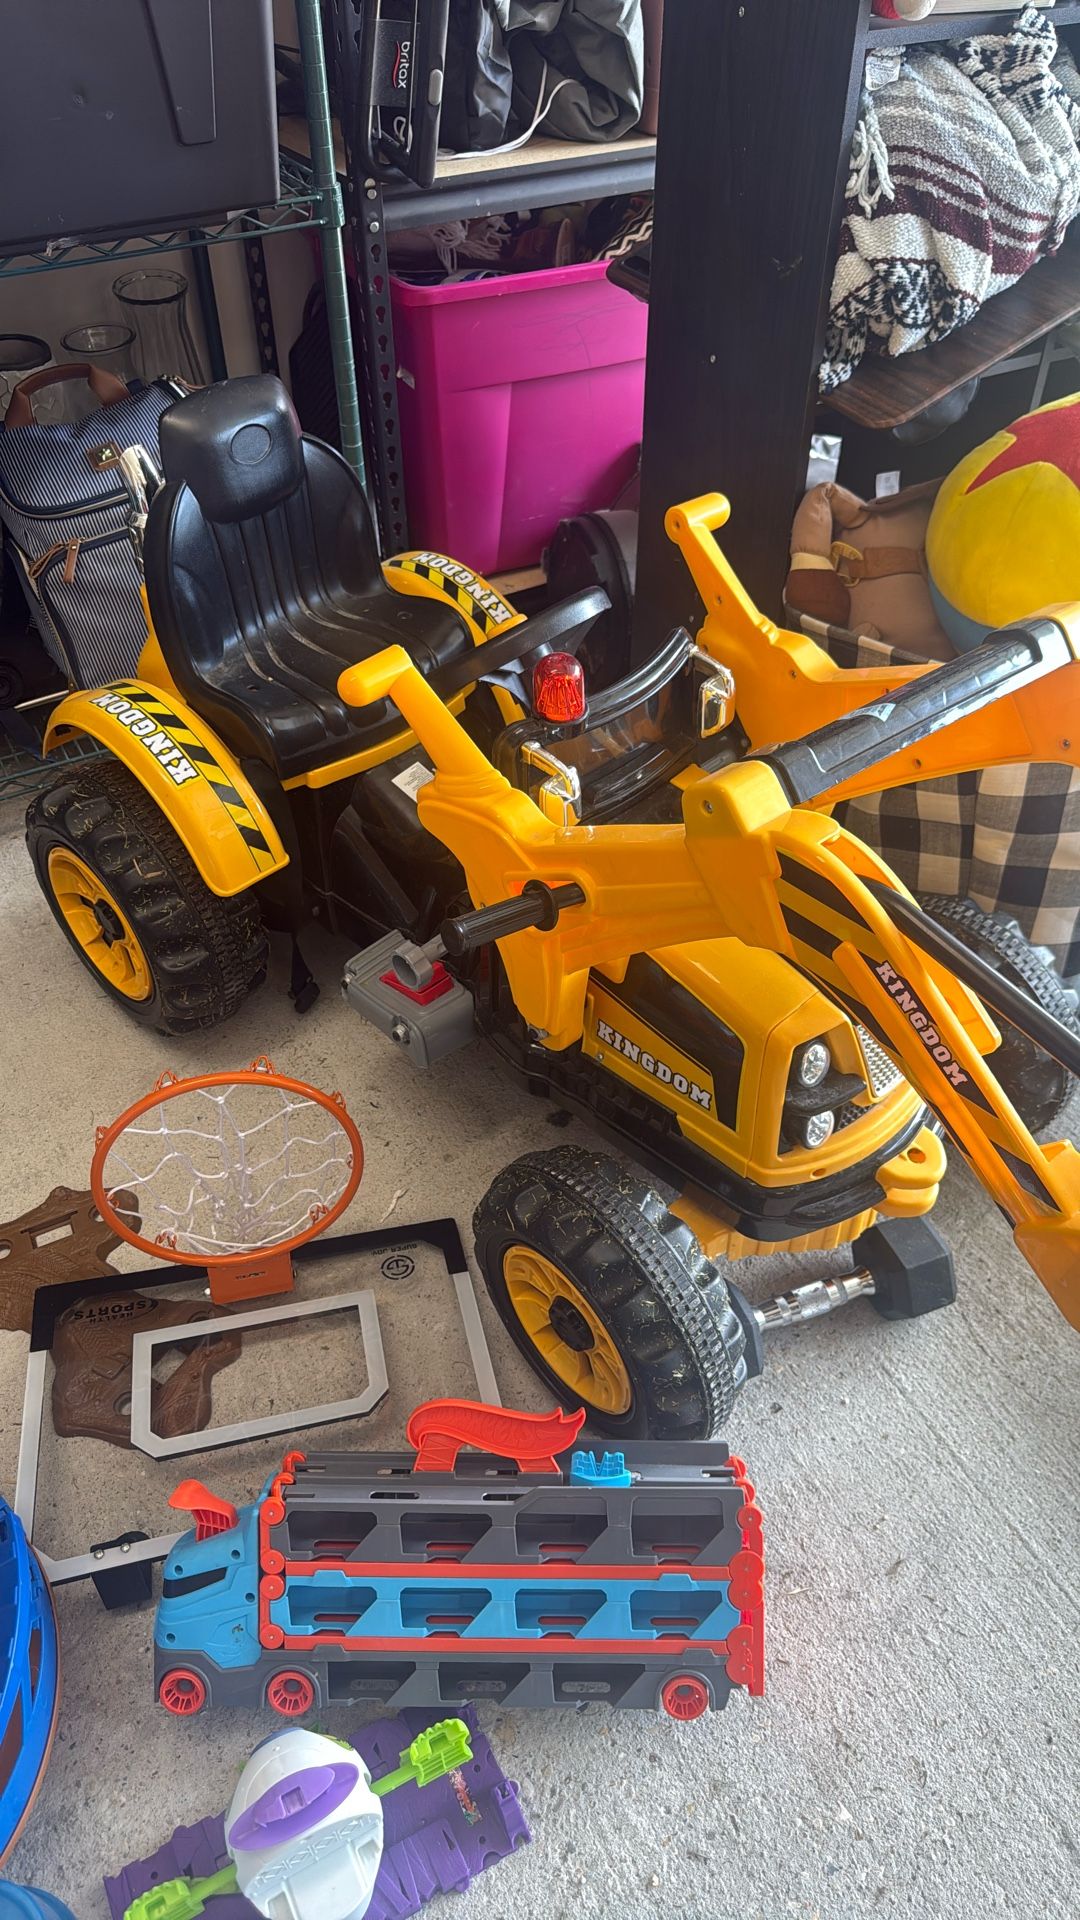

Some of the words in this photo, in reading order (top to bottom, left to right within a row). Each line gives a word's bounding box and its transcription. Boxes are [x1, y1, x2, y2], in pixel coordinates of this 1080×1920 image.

[397, 41, 411, 88] britax
[411, 552, 513, 624] KINGDOM
[89, 692, 200, 785] KINGDOM
[874, 960, 969, 1087] KINGDOM
[596, 1018, 713, 1111] KINGDOM
[391, 1243, 418, 1253] SUPER
[74, 1300, 147, 1320] SPORTS
[89, 1312, 133, 1324] HEALTH
